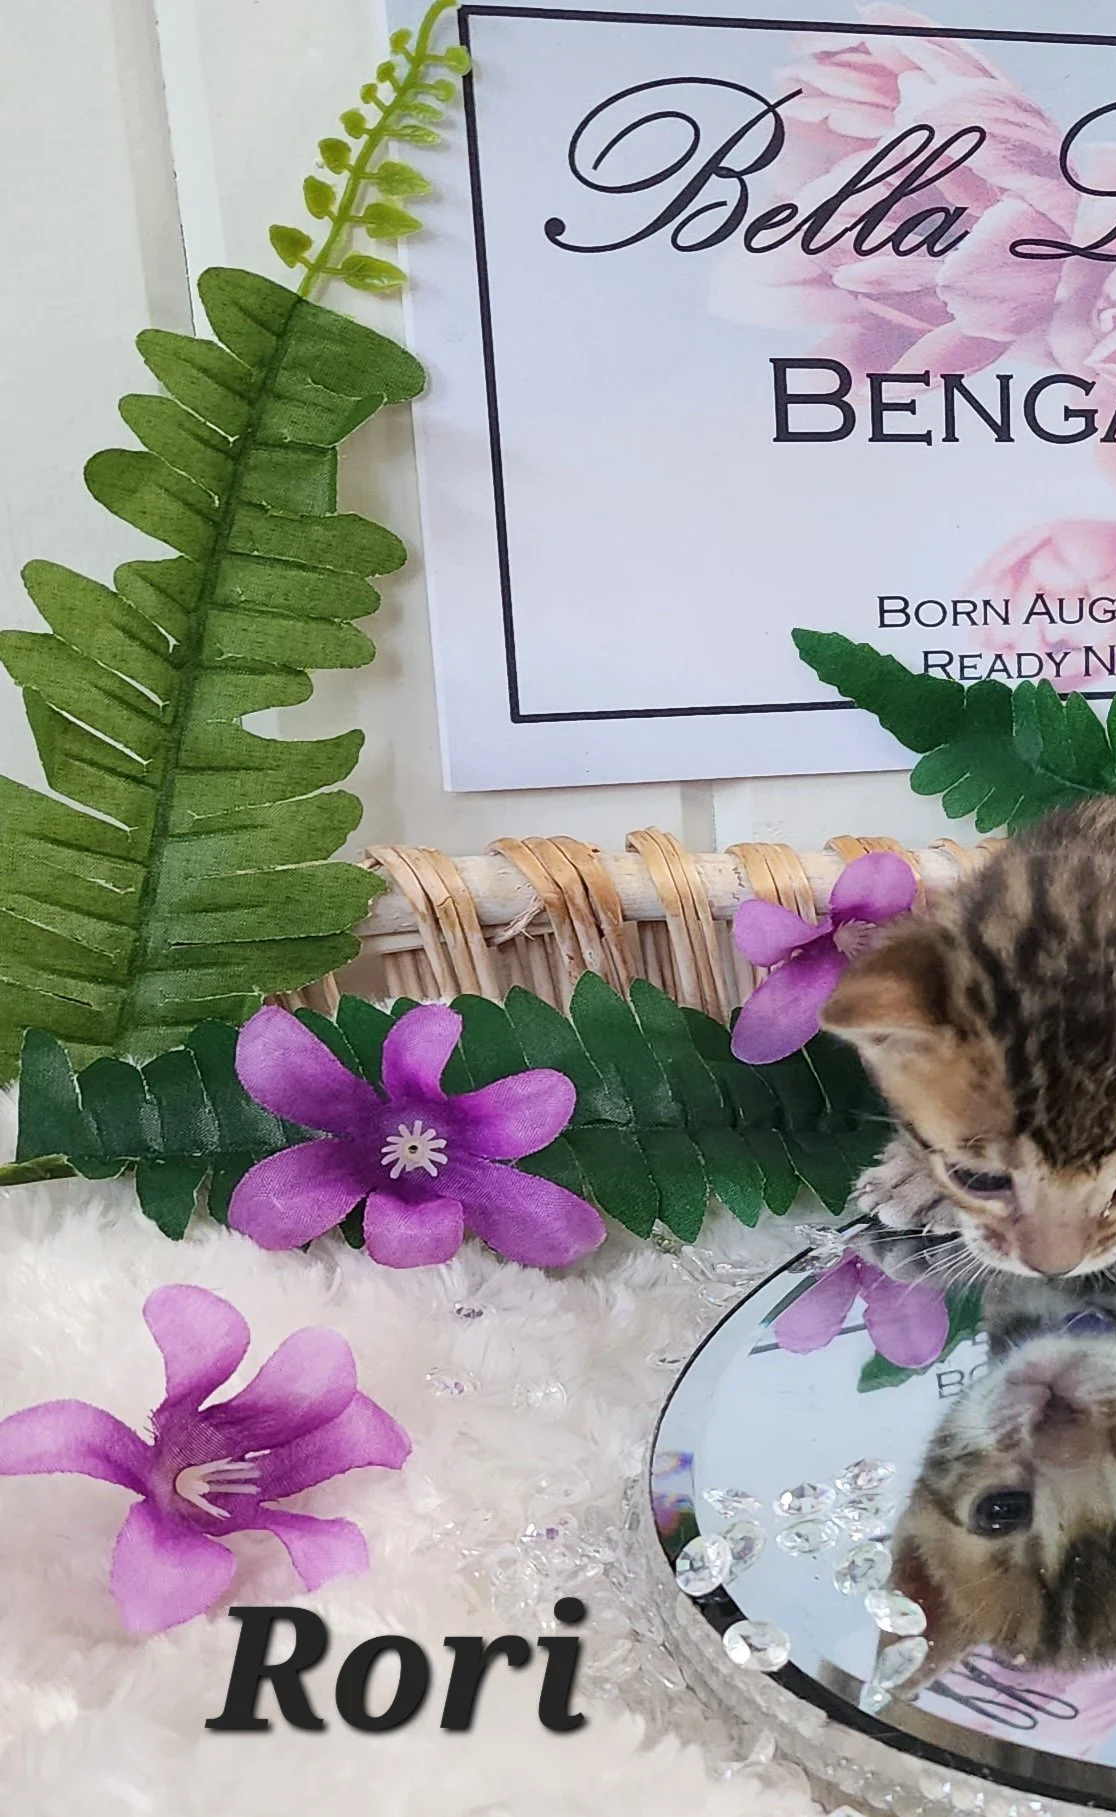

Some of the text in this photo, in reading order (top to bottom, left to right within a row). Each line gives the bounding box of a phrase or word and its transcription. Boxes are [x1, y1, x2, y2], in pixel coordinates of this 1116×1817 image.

[543, 76, 987, 258] Bella
[876, 595, 1011, 628] BORN
[921, 649, 1072, 681] READY
